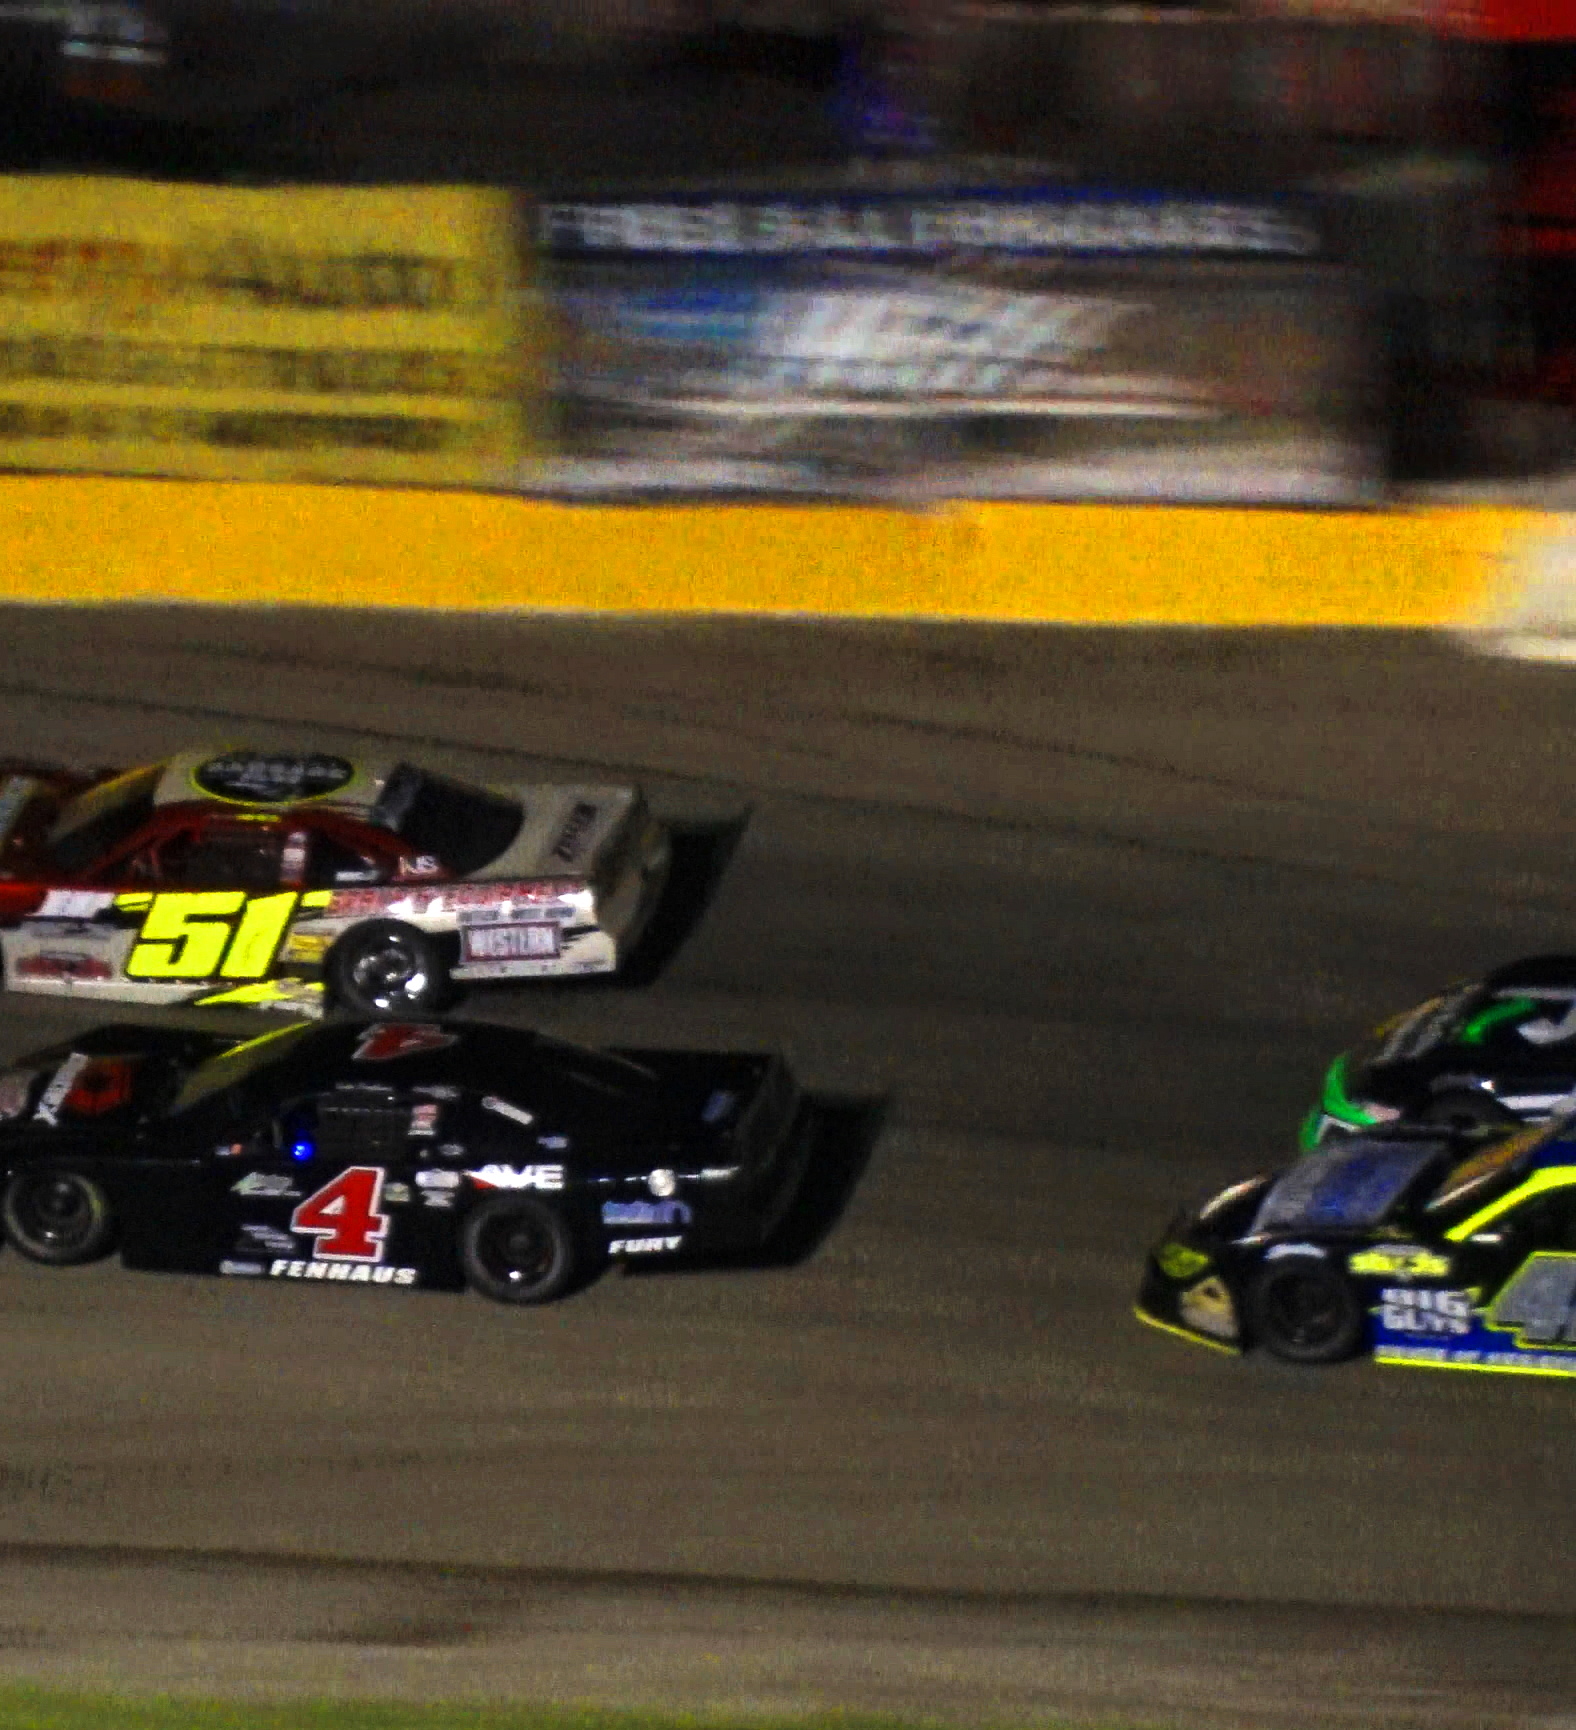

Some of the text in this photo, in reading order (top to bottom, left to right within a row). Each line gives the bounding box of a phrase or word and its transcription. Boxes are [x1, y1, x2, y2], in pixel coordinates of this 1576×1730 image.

[126, 888, 300, 980] 51
[291, 1166, 391, 1262] 4
[270, 1259, 416, 1284] FENHAUS
[608, 1235, 683, 1254] FURY
